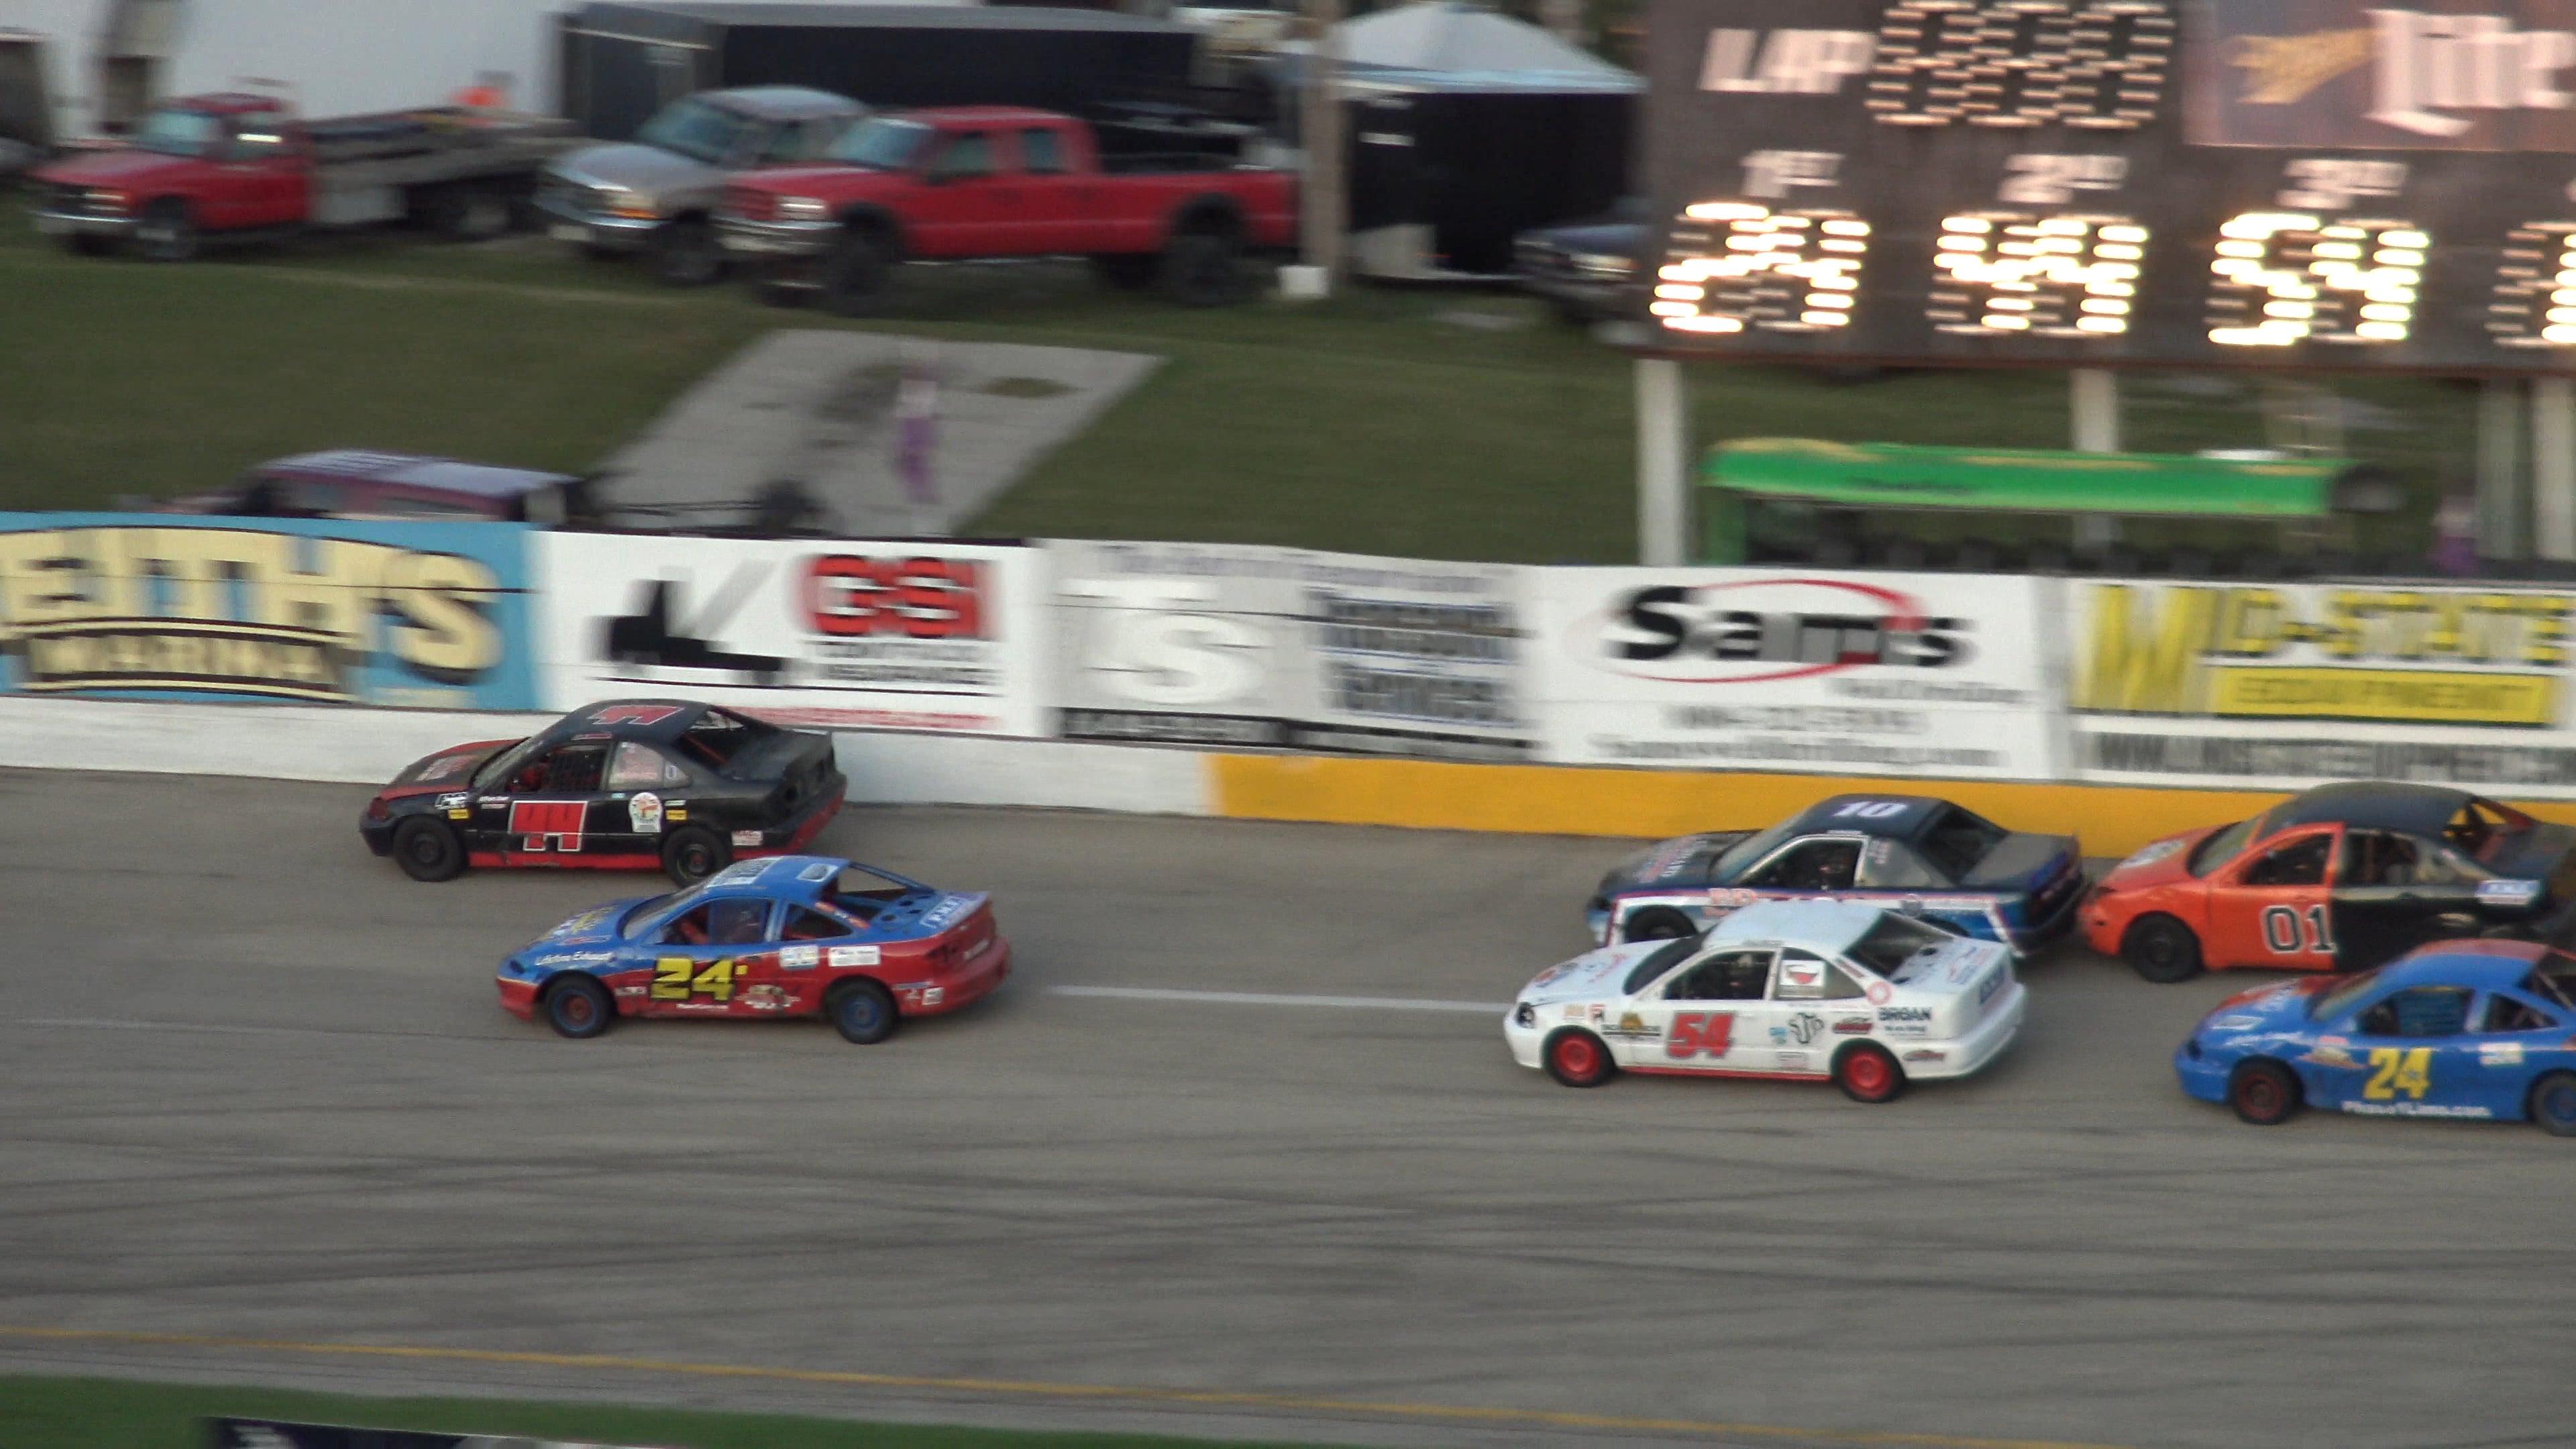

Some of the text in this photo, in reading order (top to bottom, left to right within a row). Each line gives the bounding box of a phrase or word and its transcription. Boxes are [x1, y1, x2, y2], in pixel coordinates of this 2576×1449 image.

[1699, 28, 1878, 93] LAP
[1650, 203, 1872, 333] 24
[1933, 216, 2148, 333] 44
[2208, 213, 2431, 346] 54
[1833, 800, 1909, 818] 10
[2258, 903, 2339, 955] 01
[649, 955, 735, 1001] 24
[1666, 1010, 1736, 1059] 54
[2362, 1046, 2434, 1100] 24
